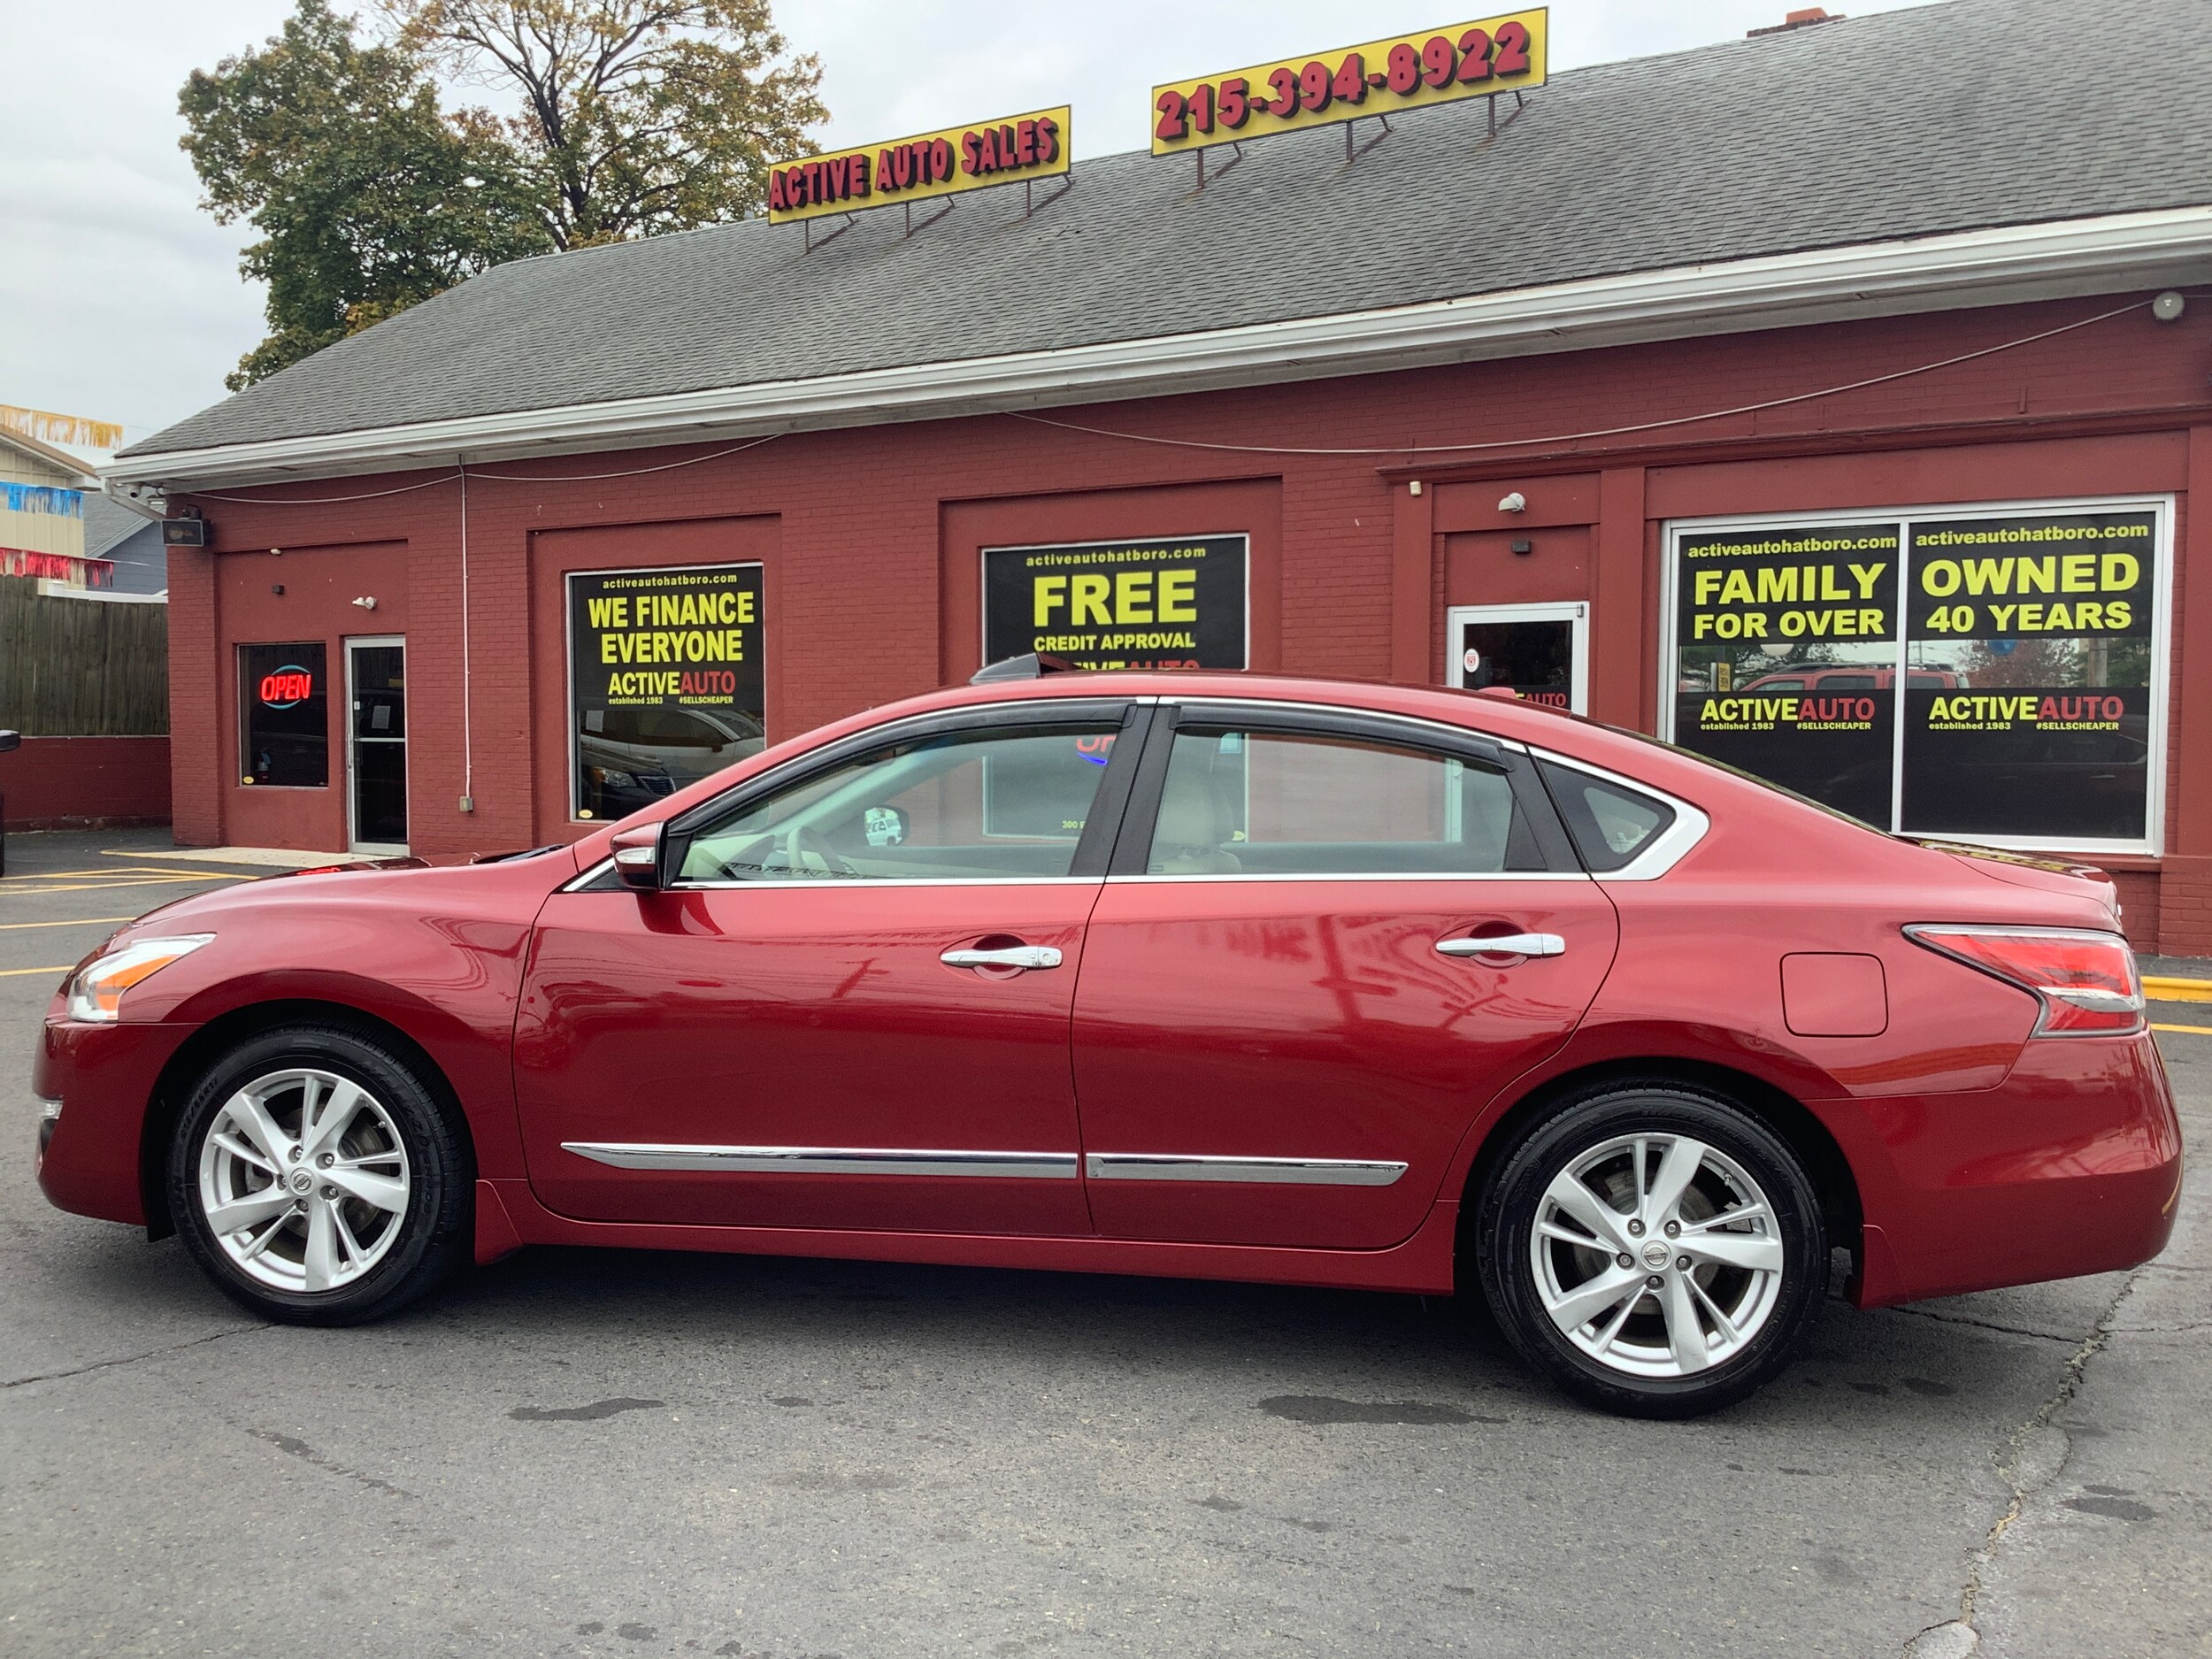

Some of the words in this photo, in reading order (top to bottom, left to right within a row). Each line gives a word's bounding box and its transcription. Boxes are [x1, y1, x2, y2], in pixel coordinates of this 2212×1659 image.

[1156, 20, 1530, 140] 215-394-8922
[769, 154, 868, 210] ACTIVE
[875, 137, 951, 191] AUTO
[961, 117, 1056, 175] SALES
[1687, 536, 1897, 558] activeautohatboro.com
[1916, 525, 2149, 547] activeautohatboro.com
[1025, 547, 1207, 567] activeautohatboro.com
[603, 574, 738, 589] activeautohatboro.com
[1694, 563, 1887, 606] FAMILY
[1921, 553, 2140, 597] OWNED
[588, 596, 629, 628] WE
[635, 591, 755, 627] FINANCE
[1033, 569, 1197, 627] FREE
[1694, 613, 1769, 640] FOR
[1778, 608, 1886, 637] OVER
[1925, 605, 1975, 633] 40
[1987, 601, 2132, 632] YEARS
[601, 629, 743, 664] EVERYONE
[1033, 634, 1098, 652] CREDIT
[1100, 632, 1196, 650] APPROVAL
[259, 673, 311, 702] OPEN
[608, 671, 736, 695] ACTIVEAUTO
[608, 696, 645, 705] established
[646, 695, 664, 705] 1983
[679, 695, 733, 704] #SELLSCHEAPER
[1700, 697, 1876, 721] ACTIVEAUTO
[1928, 695, 2124, 720] ACTIVEAUTO
[1700, 722, 1750, 731] established
[1751, 722, 1775, 731] 1983
[1796, 722, 1871, 731] #SELLSCHEAPER
[1929, 721, 1983, 730] established
[1985, 721, 2011, 730] 1983
[2035, 721, 2119, 731] #SELLSCHEAPER
[1062, 820, 1078, 829] 300
